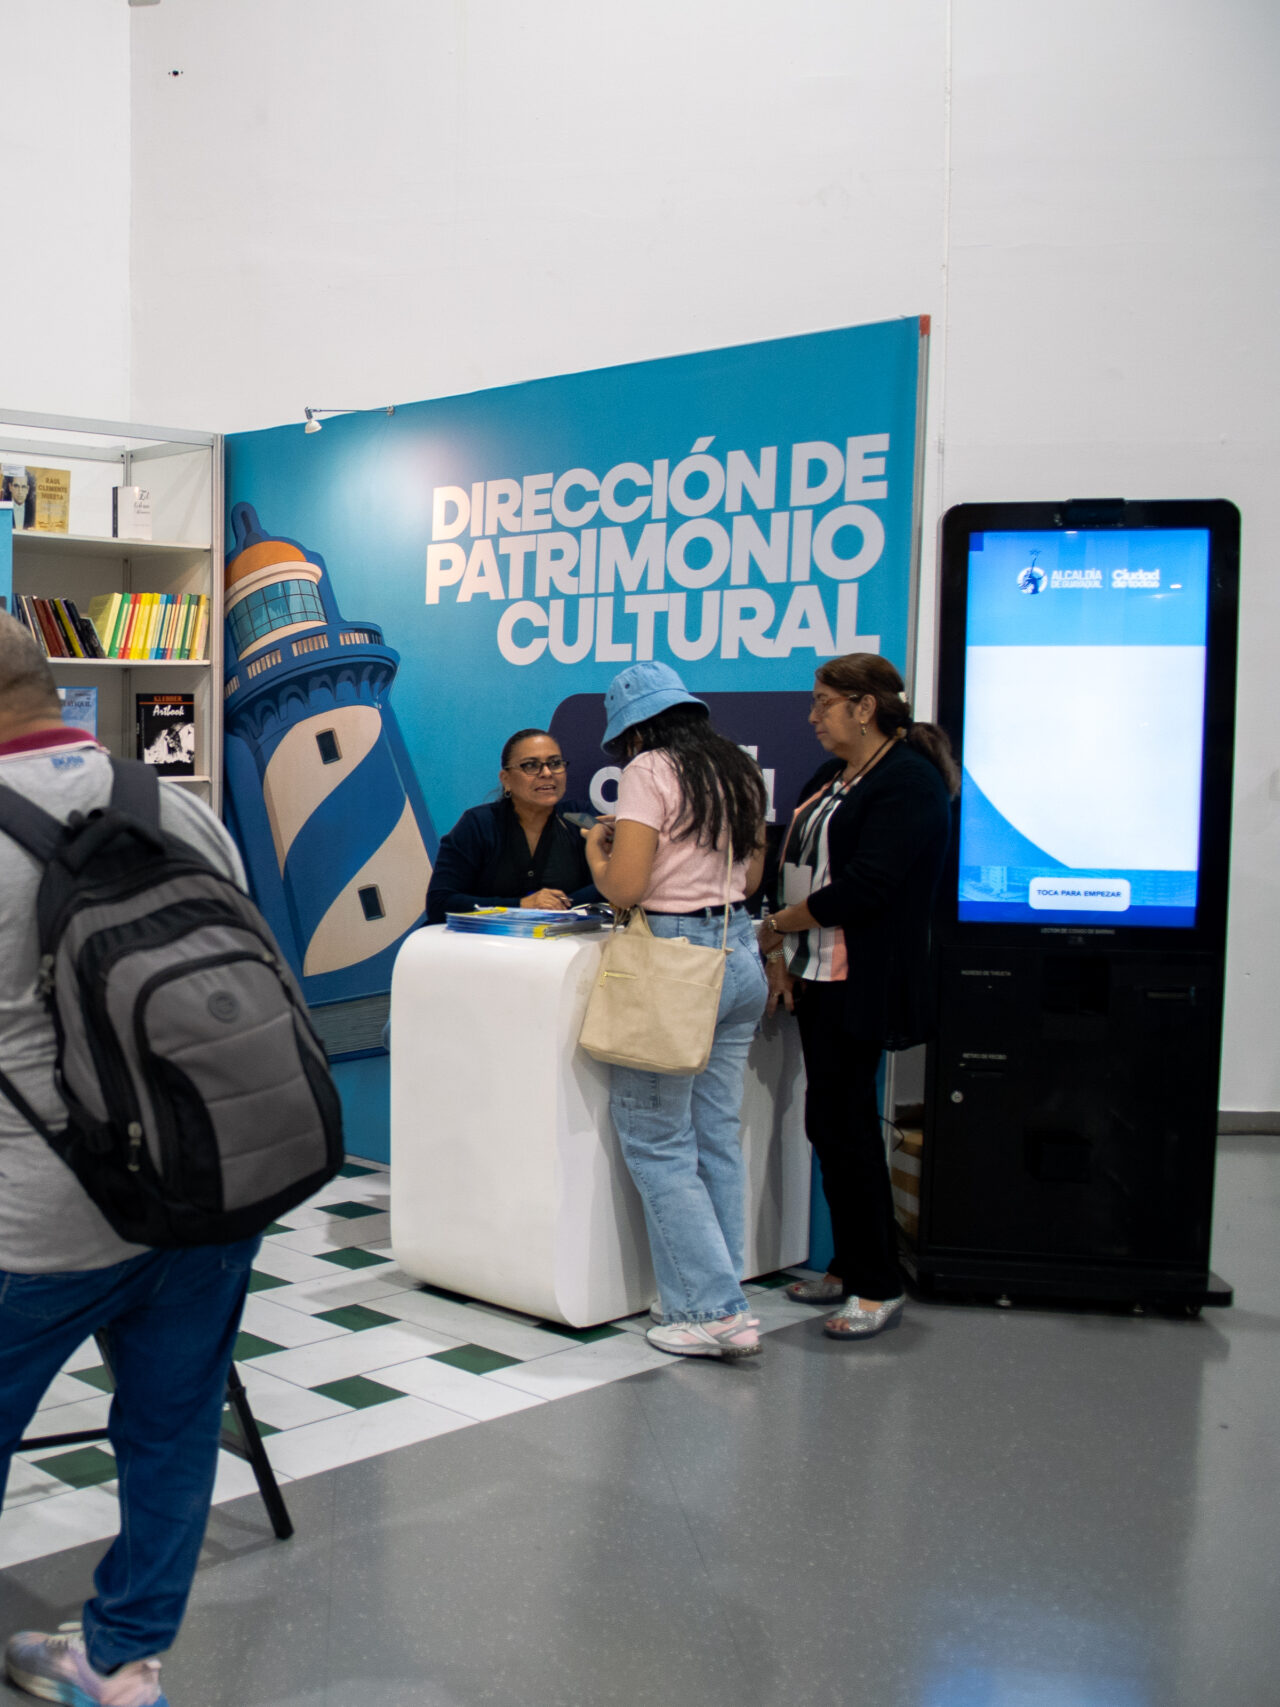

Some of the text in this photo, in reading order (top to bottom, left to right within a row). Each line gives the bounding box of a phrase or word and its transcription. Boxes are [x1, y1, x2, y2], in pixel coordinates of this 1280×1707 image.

[431, 433, 890, 542] DIRECCIÓN DE
[424, 504, 886, 605] PATRIMONIO
[496, 582, 881, 666] CULTURAL
[1061, 889, 1082, 897] PARA
[1083, 890, 1122, 898] EMPEZAR
